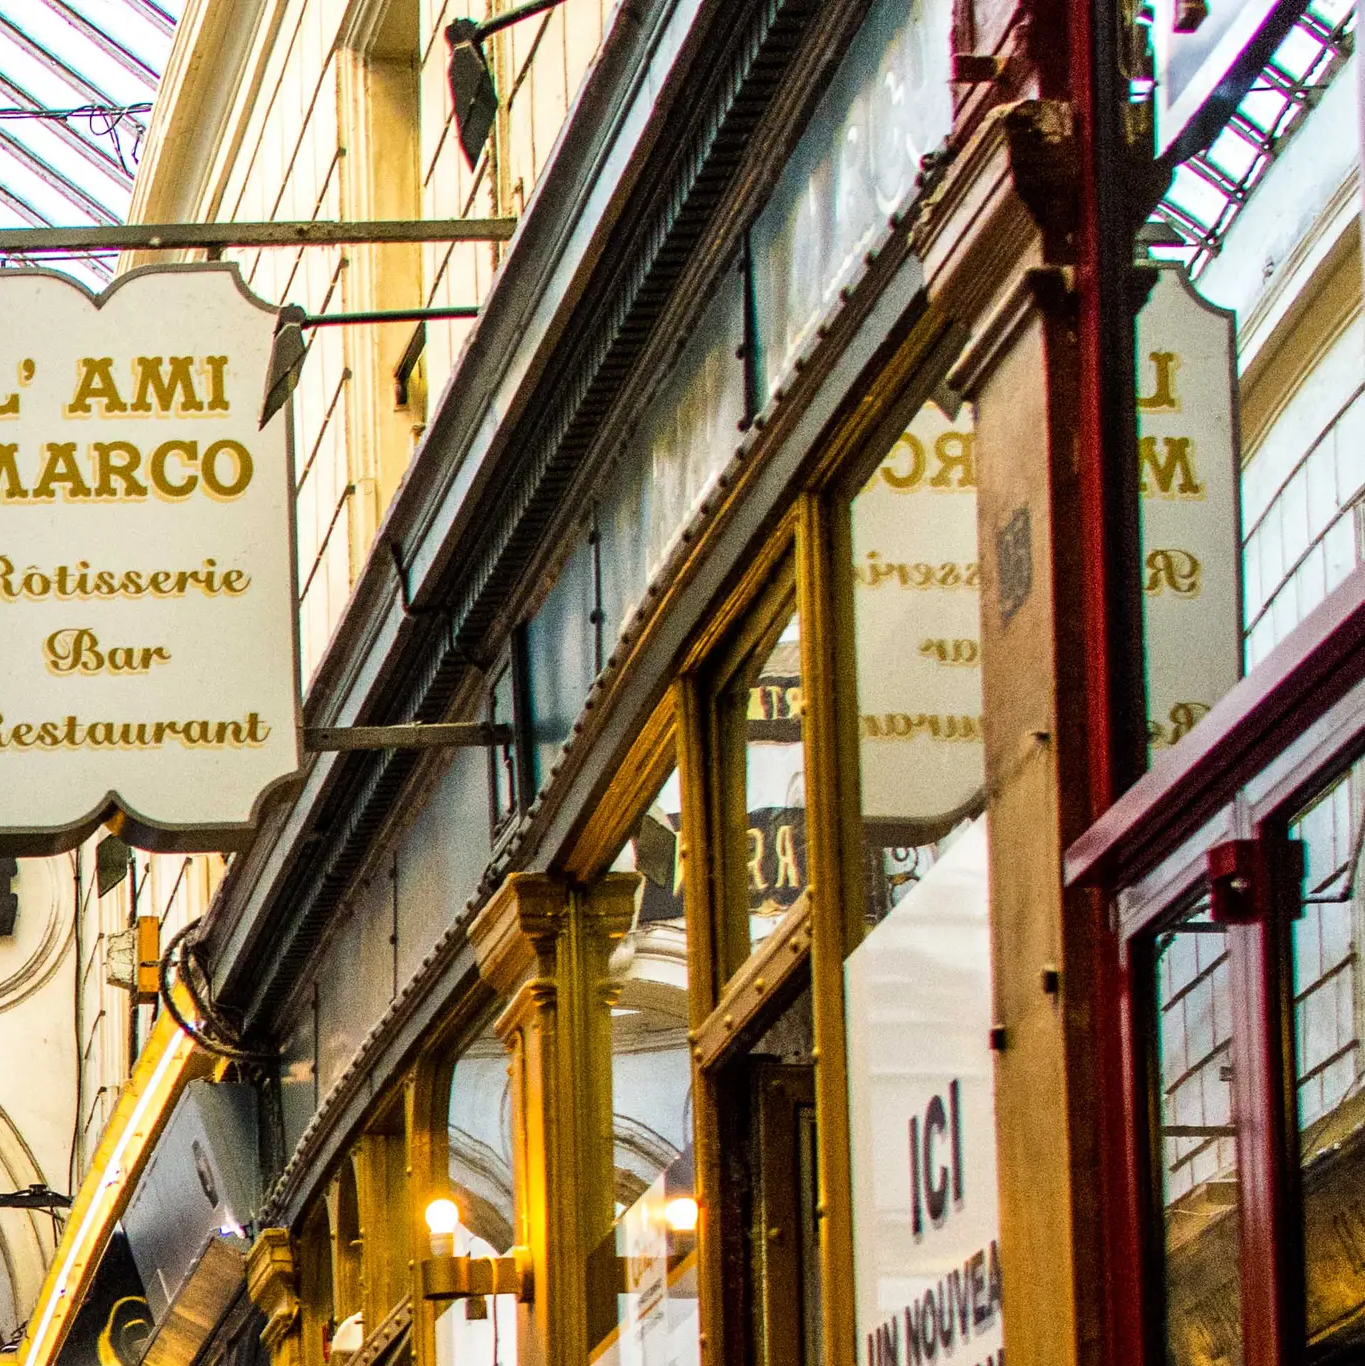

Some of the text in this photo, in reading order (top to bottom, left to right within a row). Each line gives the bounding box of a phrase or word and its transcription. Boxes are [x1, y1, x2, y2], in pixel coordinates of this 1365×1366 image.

[64, 355, 230, 418] AMI
[44, 627, 171, 677] Bar
[908, 1078, 963, 1237] ICI
